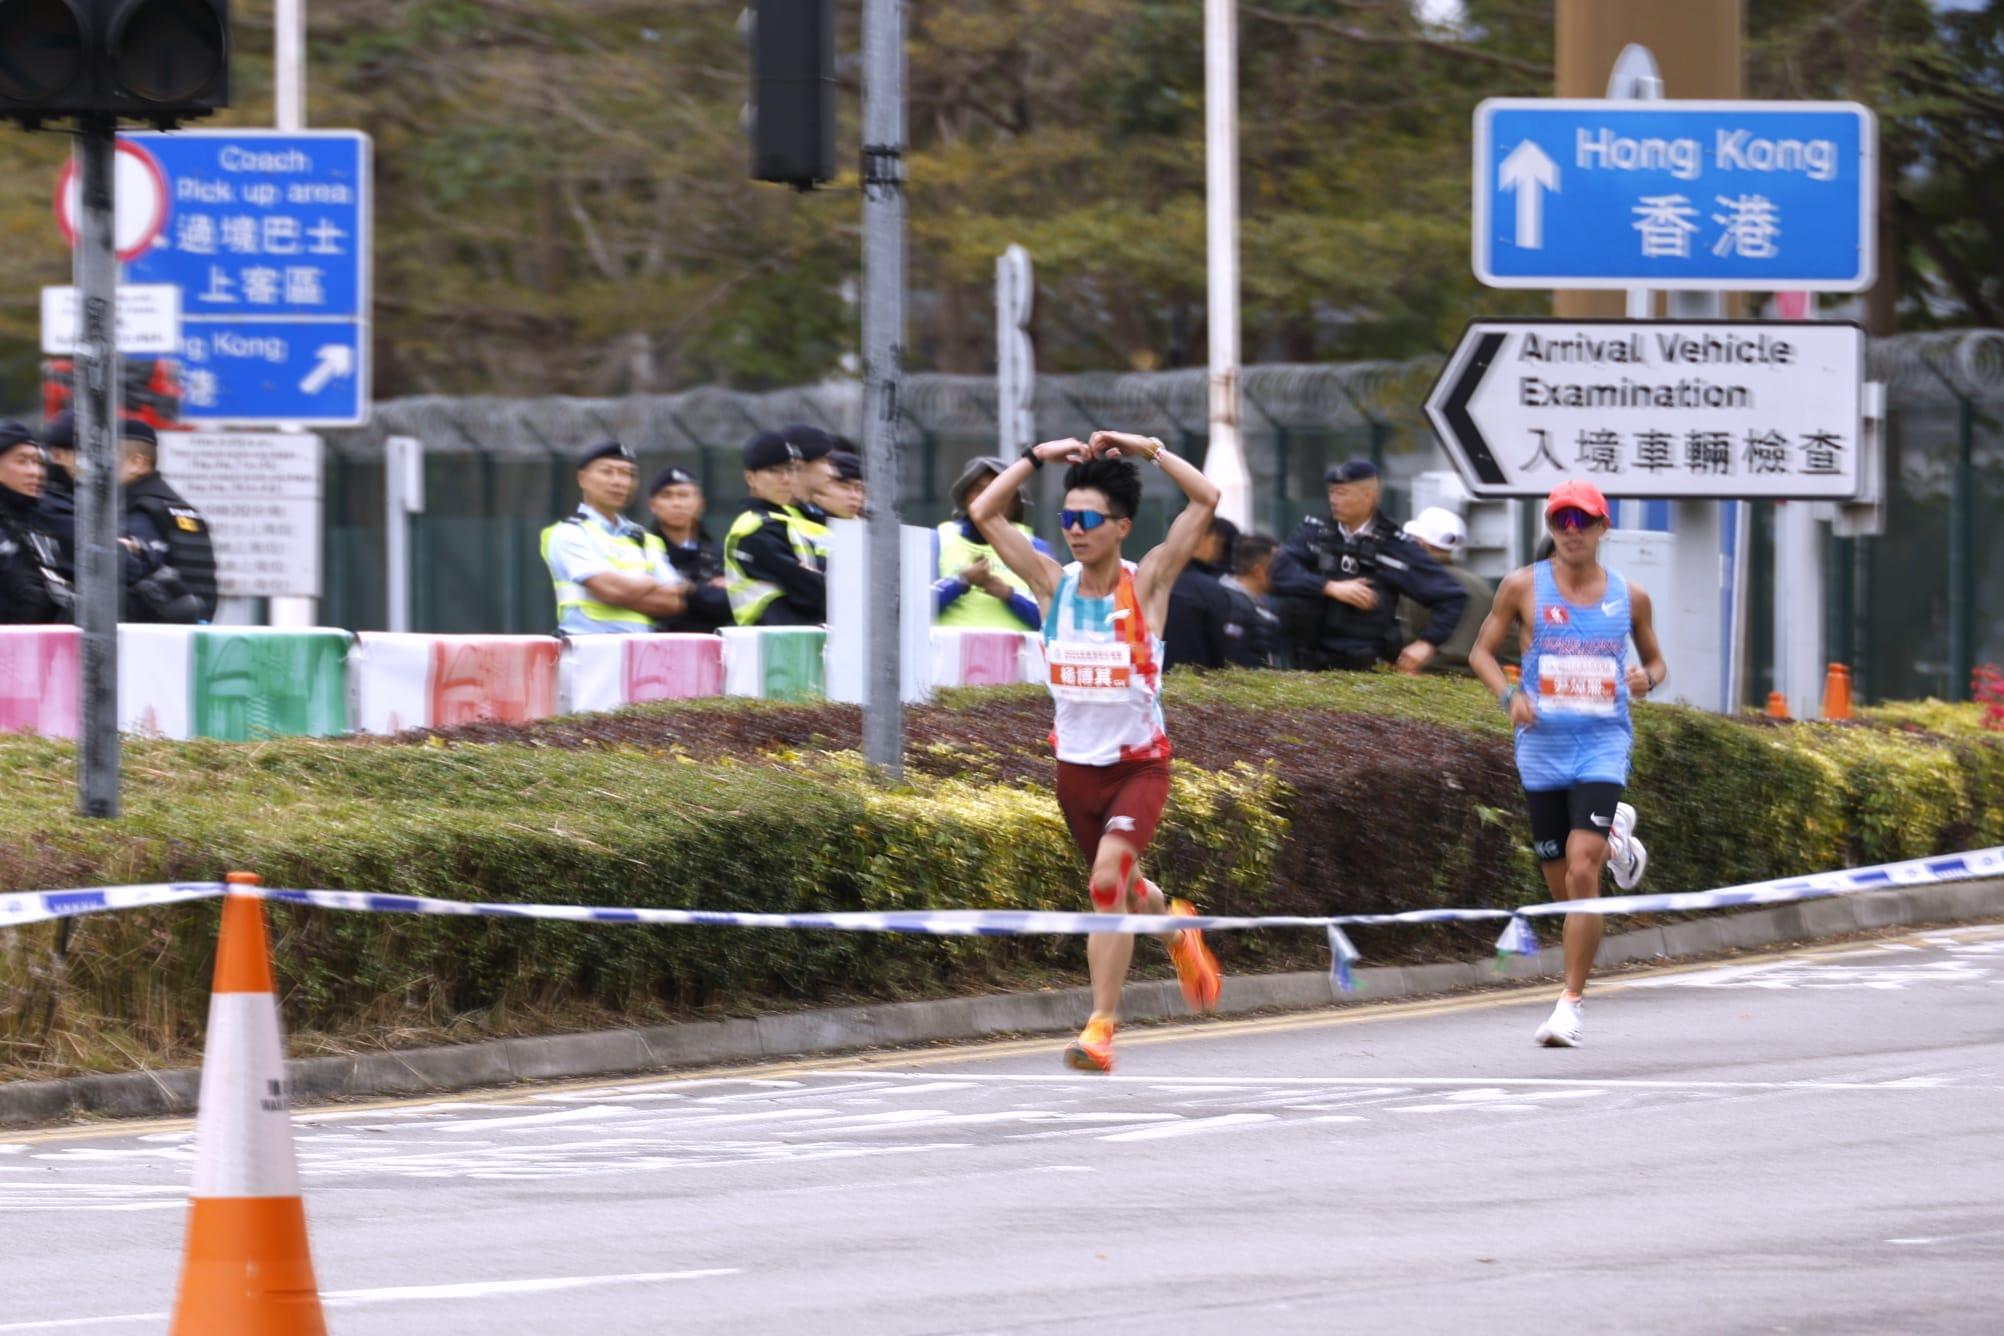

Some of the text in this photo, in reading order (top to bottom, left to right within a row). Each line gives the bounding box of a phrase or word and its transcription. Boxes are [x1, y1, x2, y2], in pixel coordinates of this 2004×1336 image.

[219, 145, 312, 172] Coach
[1576, 127, 1837, 181] Hong Kong
[243, 183, 281, 208] up
[288, 183, 352, 204] area
[1631, 193, 1782, 258] 香港
[198, 264, 326, 304] 上客區
[213, 331, 288, 363] Kong
[1518, 332, 1796, 364] Arrival Vehicle
[1518, 376, 1754, 408] Examination
[1518, 427, 1846, 476] 入境車輛檢查
